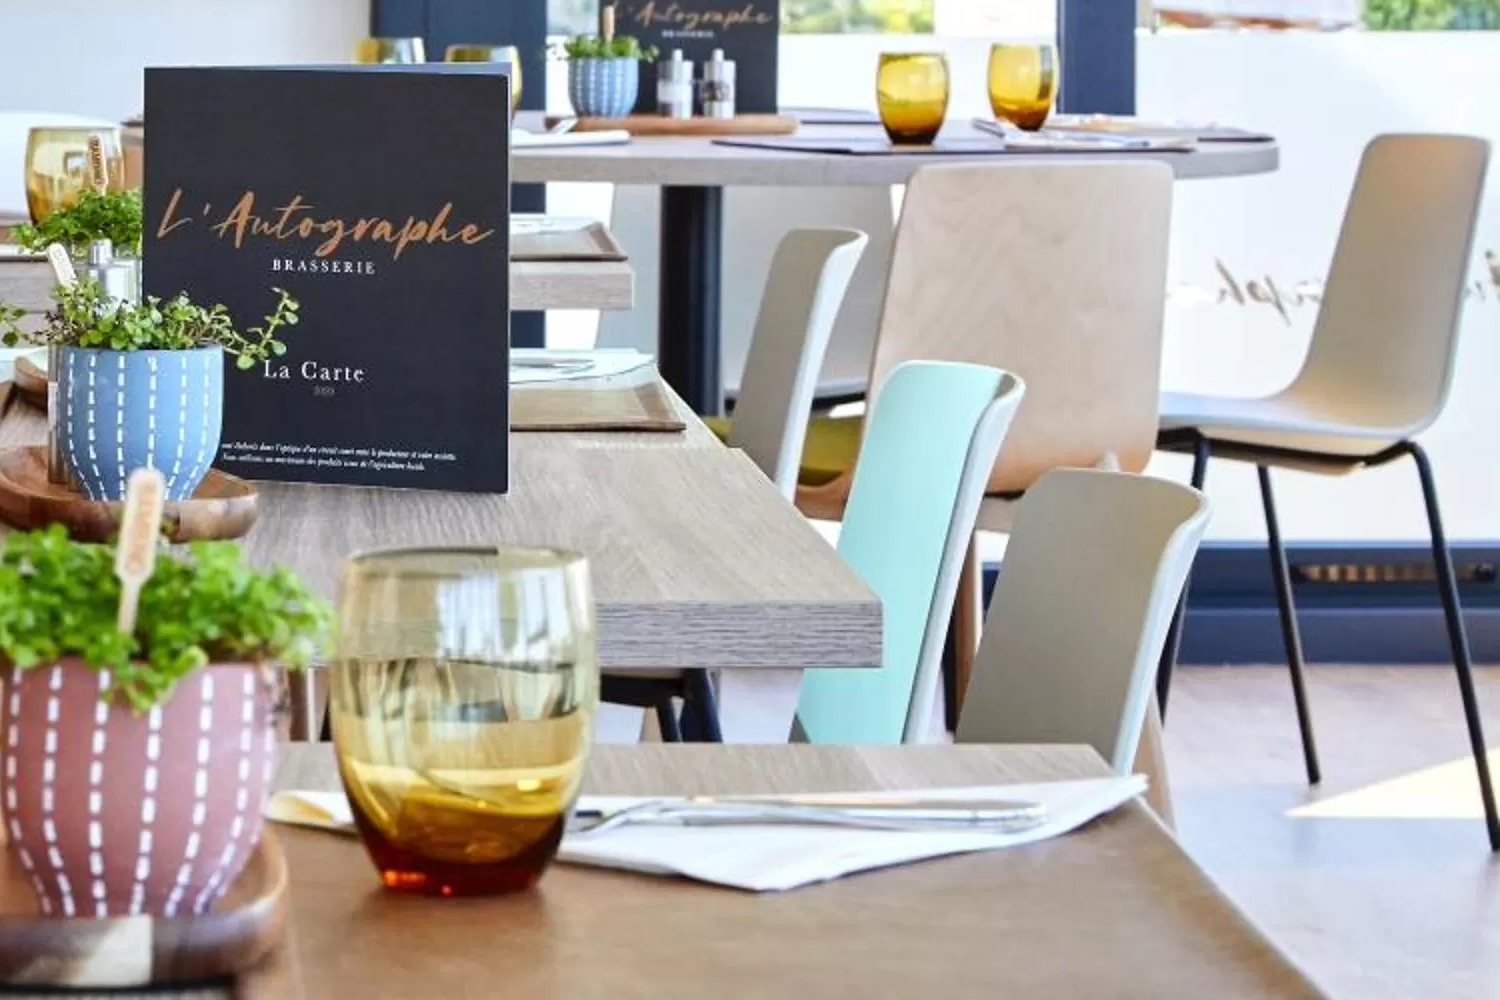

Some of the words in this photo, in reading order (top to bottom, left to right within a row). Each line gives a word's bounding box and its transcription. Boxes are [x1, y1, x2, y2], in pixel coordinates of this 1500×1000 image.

[156, 187, 495, 261] L'Autographe
[271, 258, 376, 275] BRASSERIE
[263, 359, 291, 379] La
[301, 361, 364, 382] Carte
